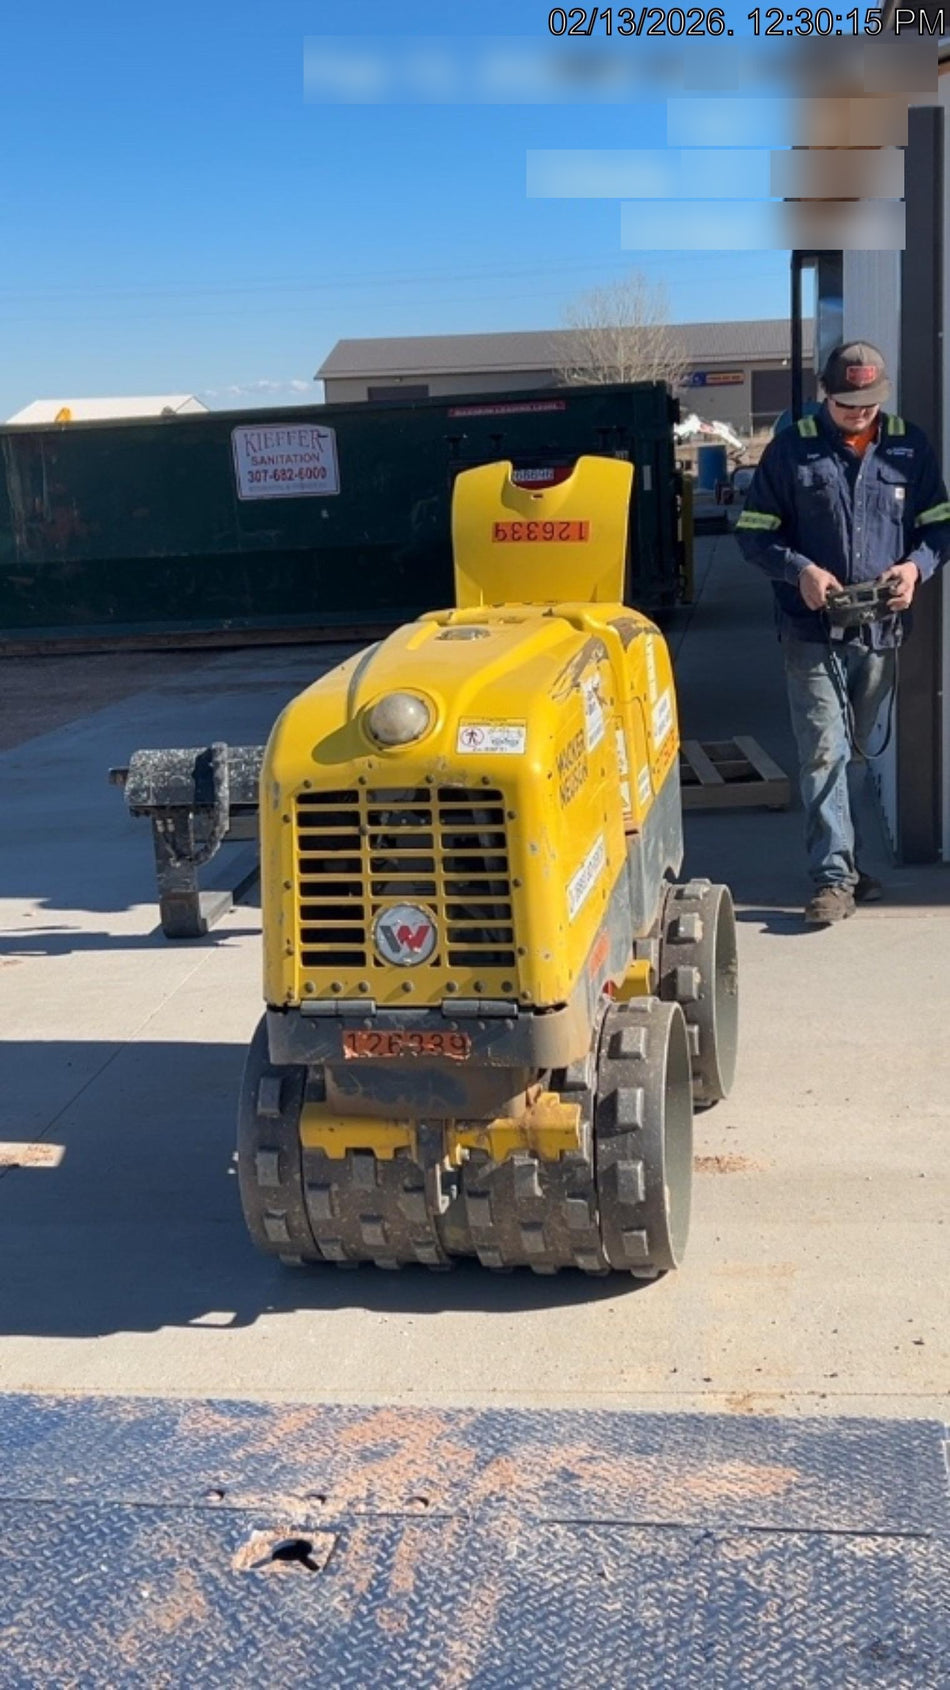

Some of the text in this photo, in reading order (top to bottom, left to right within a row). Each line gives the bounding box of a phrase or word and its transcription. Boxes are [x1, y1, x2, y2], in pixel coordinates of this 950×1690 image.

[244, 429, 324, 456] KIEFFER
[251, 453, 320, 466] SANITATION
[247, 466, 328, 483] 307-682-6000
[494, 521, 586, 541] 126339
